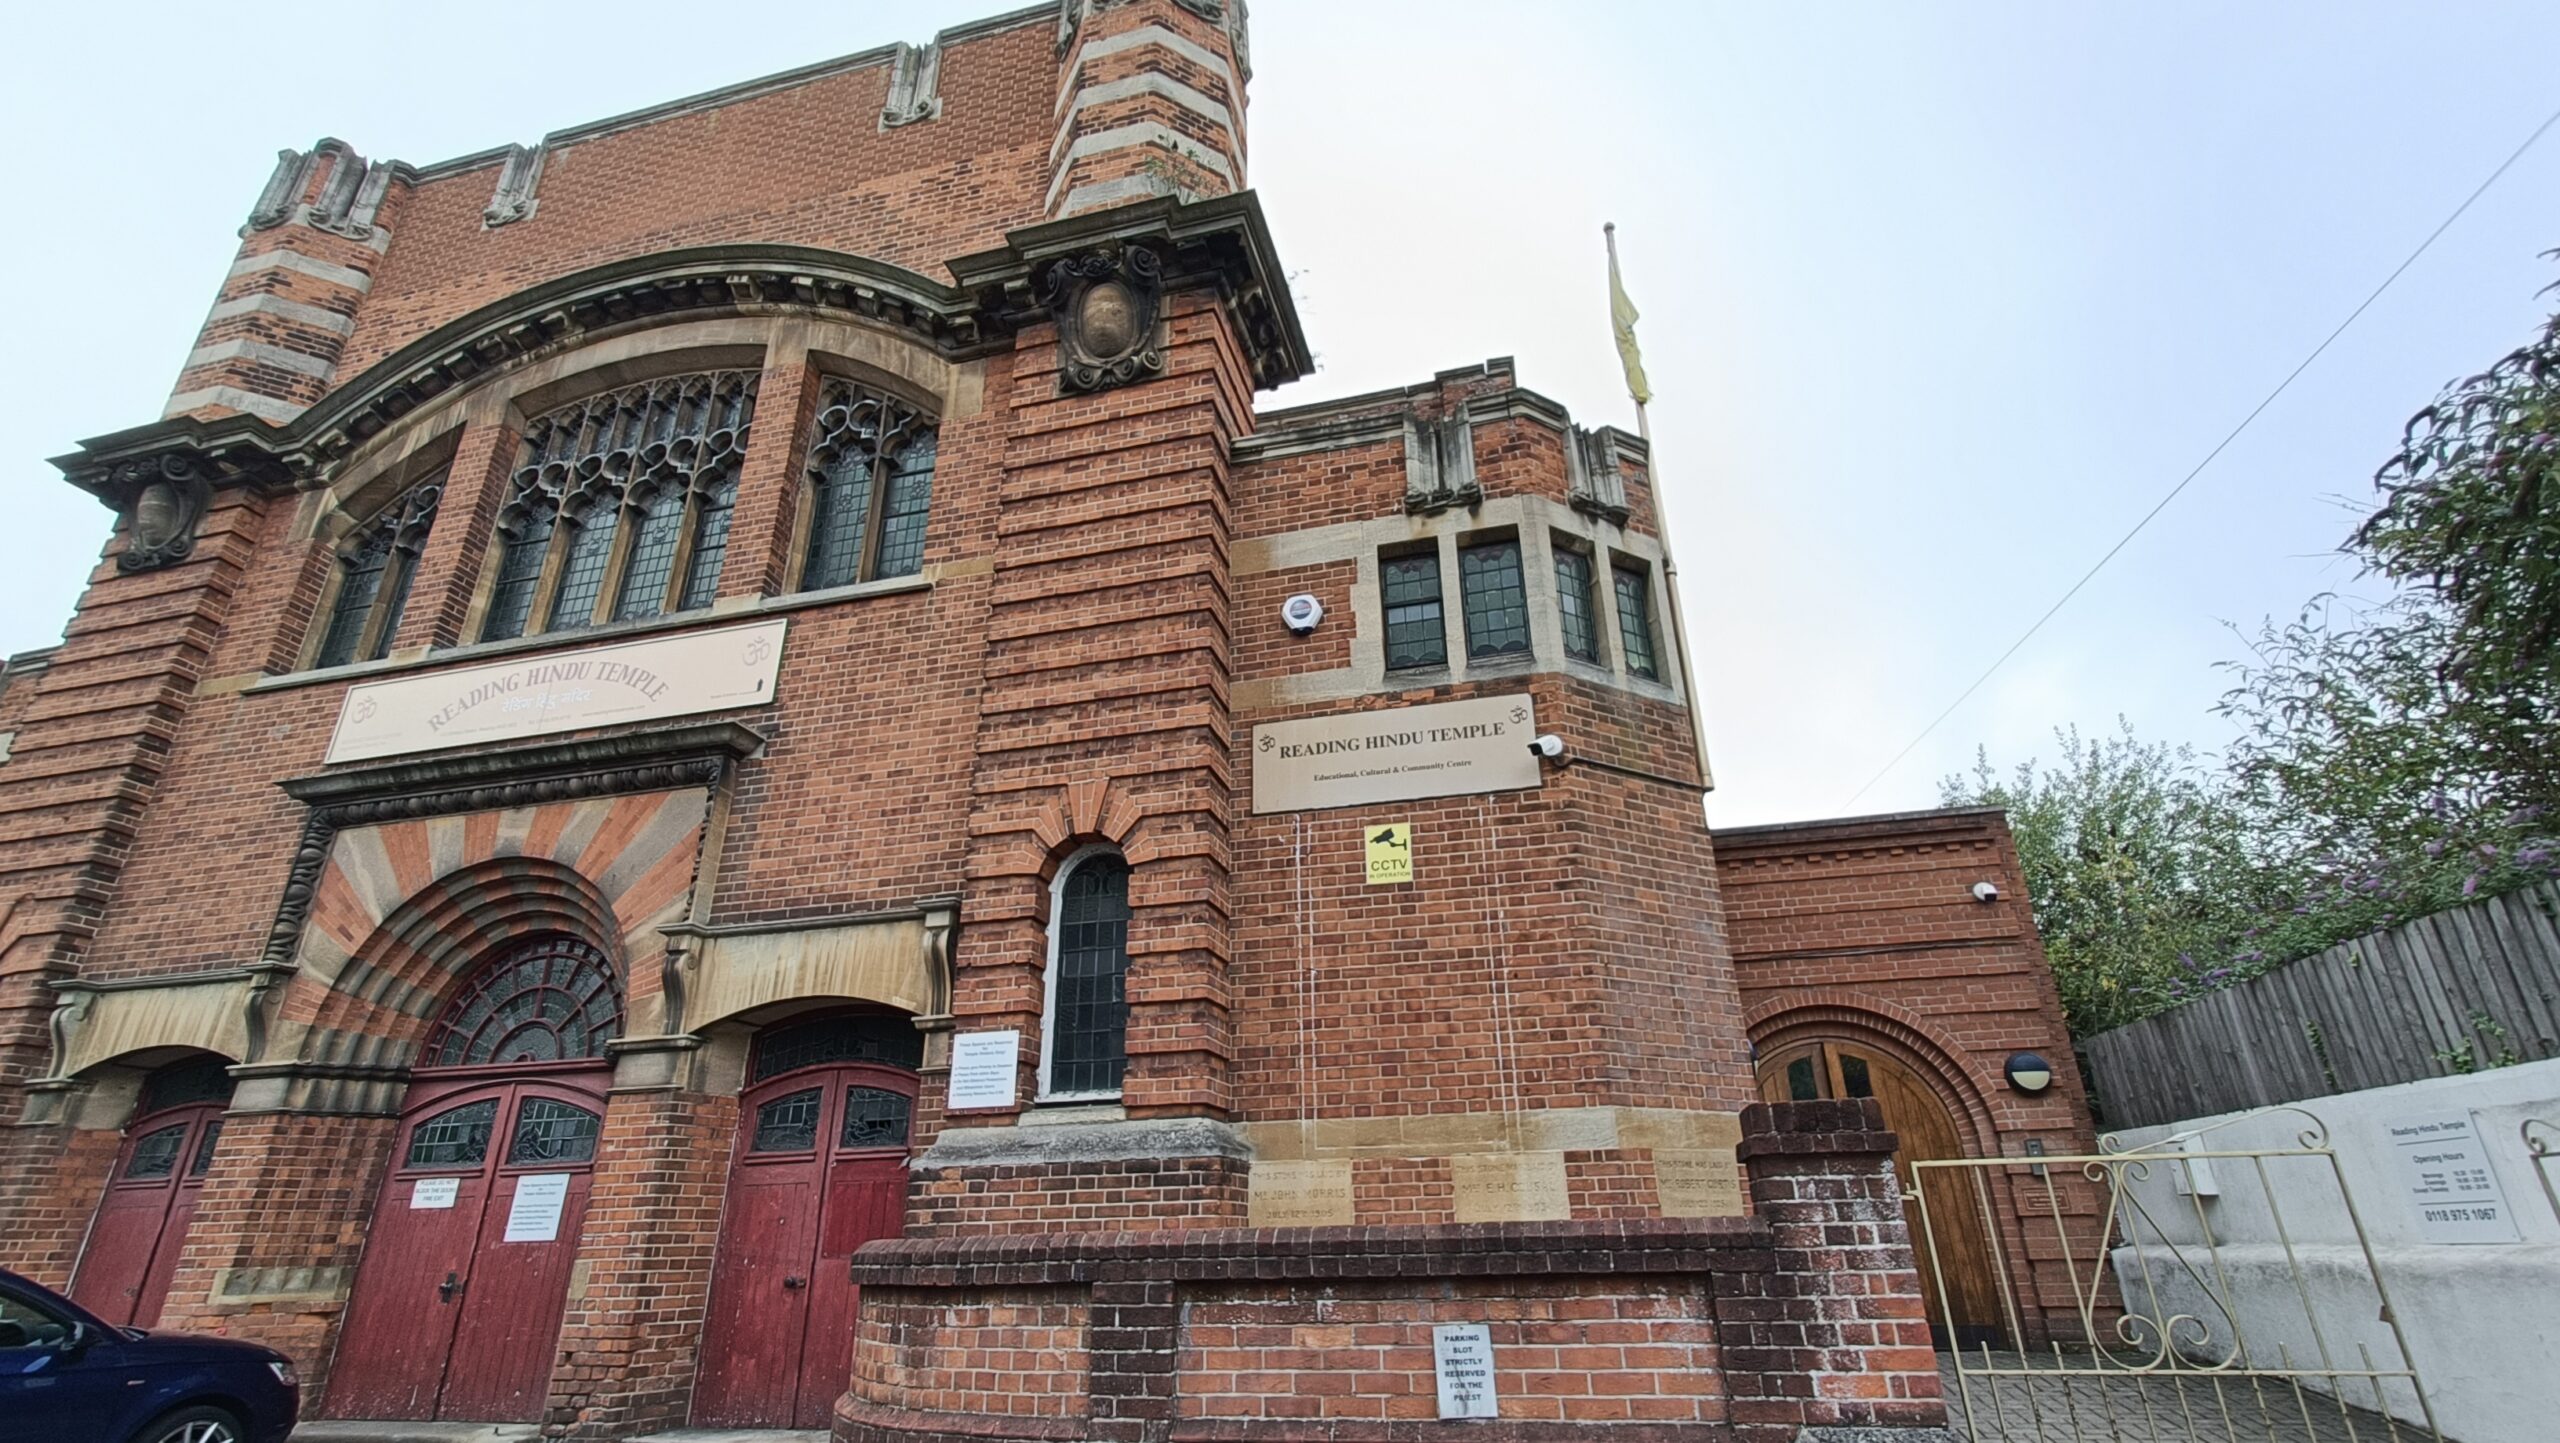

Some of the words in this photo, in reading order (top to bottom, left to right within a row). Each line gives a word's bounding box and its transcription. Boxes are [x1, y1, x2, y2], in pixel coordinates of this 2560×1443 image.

[427, 673, 520, 732] READING
[525, 661, 593, 687] HINDU
[594, 661, 670, 703] TEMPLE
[1280, 738, 1360, 759] READING
[1365, 730, 1424, 750] HINDU
[1427, 721, 1506, 743] TEMPLE
[1360, 766, 1391, 777] Cultural
[1392, 766, 1400, 774] &
[1401, 761, 1445, 773] Community
[1446, 759, 1472, 768] Centre
[1371, 858, 1408, 872] CCTV
[2391, 1126, 2419, 1136] Reading
[2419, 1124, 2439, 1132] Hindu
[2439, 1121, 2466, 1131] Temple
[2413, 1154, 2443, 1164] Opening
[2442, 1152, 2465, 1160] Hours
[2425, 1209, 2449, 1221] 0118
[2450, 1208, 2470, 1221] 975
[2471, 1207, 2496, 1221] 1067
[1444, 1334, 1480, 1342] PARKING
[1453, 1346, 1473, 1354] SLOT
[1445, 1358, 1483, 1366] STRICTLY
[1444, 1369, 1486, 1378] RESERVED
